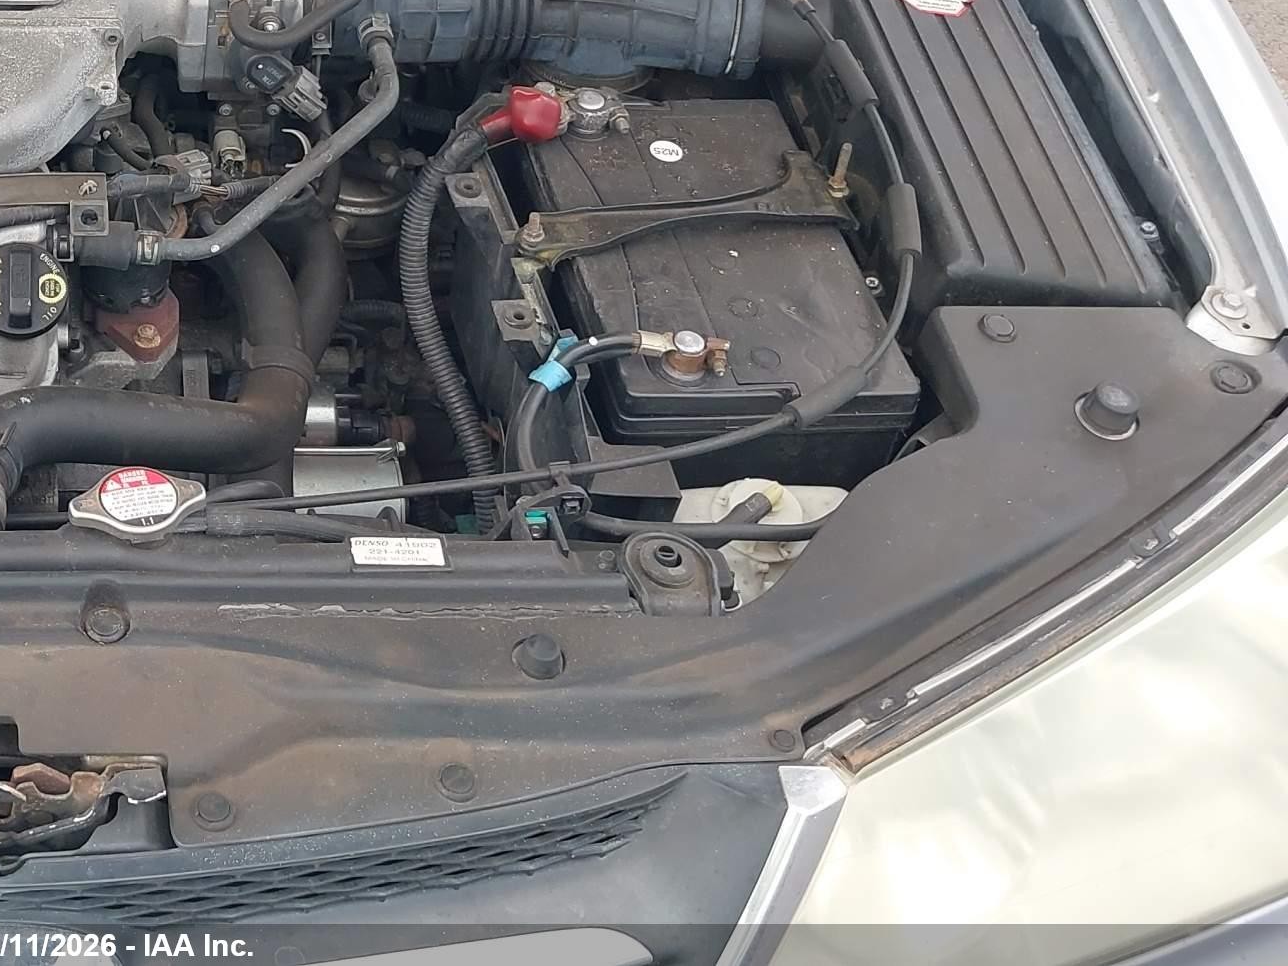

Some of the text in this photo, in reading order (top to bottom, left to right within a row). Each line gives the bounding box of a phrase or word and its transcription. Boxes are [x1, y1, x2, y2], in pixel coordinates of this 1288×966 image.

[39, 253, 61, 274] ENGINE
[42, 306, 57, 320] OIL
[140, 516, 155, 527] 1.1
[354, 539, 389, 547] DENSO
